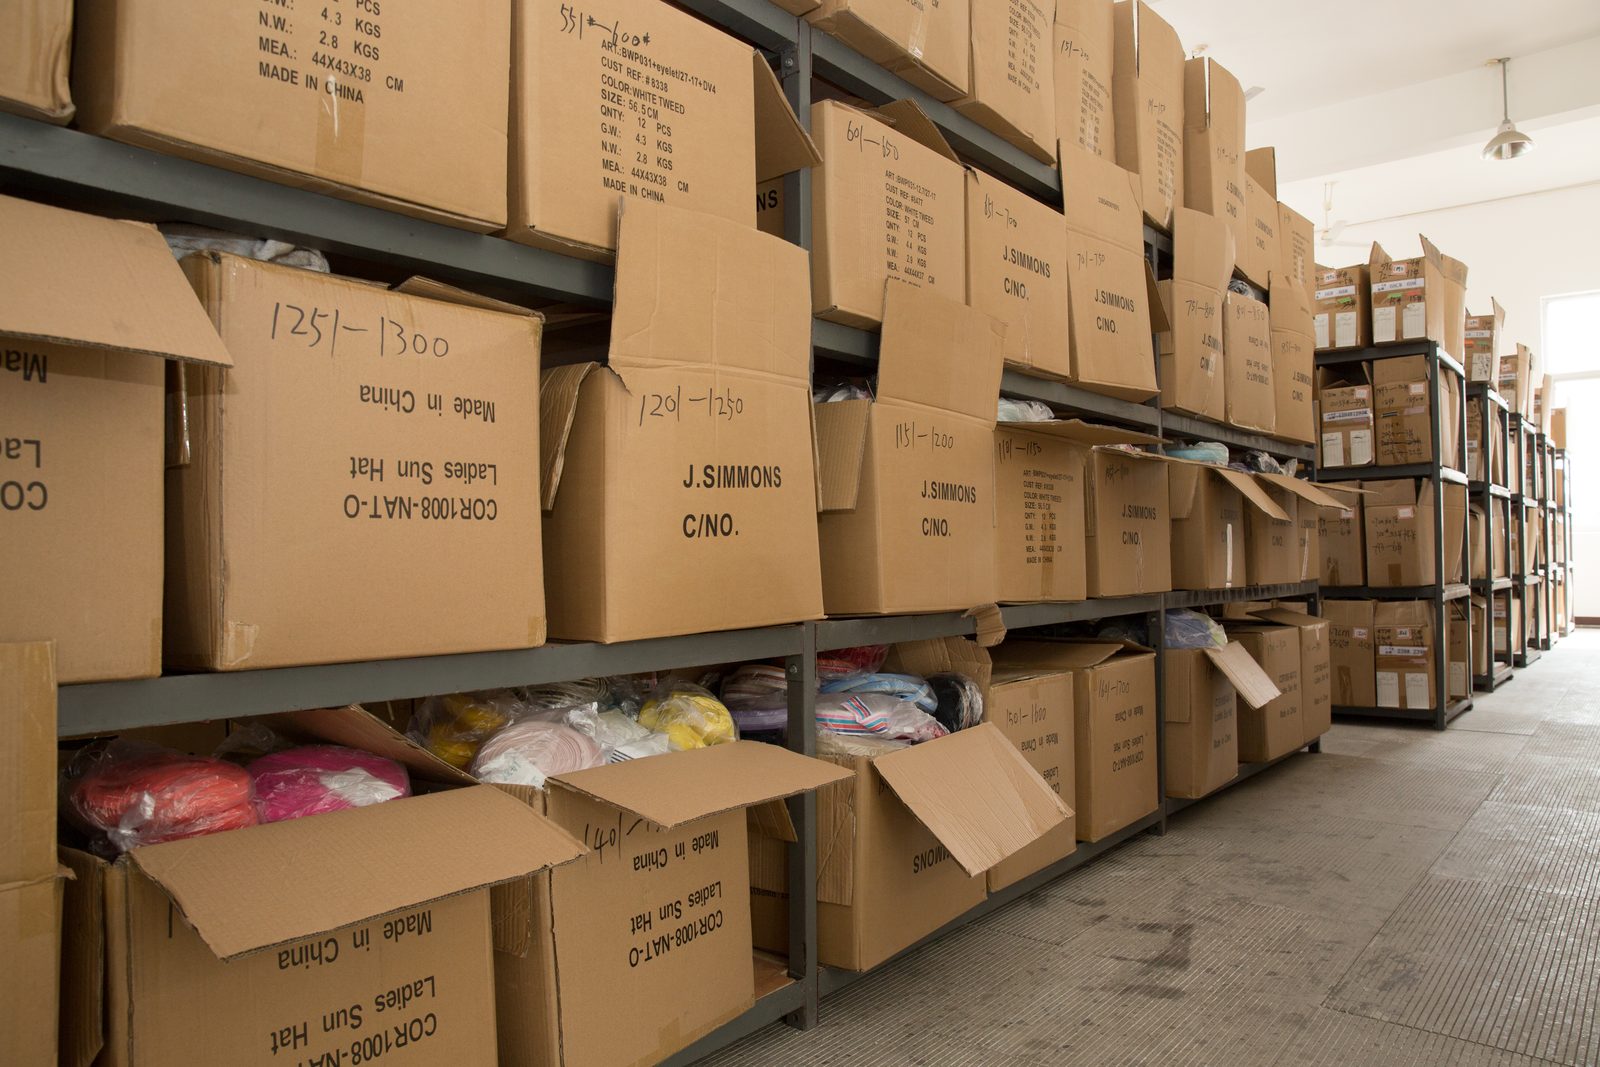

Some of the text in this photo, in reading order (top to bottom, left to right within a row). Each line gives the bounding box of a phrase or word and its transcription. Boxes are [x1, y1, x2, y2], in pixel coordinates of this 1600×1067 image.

[259, 11, 380, 61] N.W.: 2.8 KGS
[321, 7, 381, 39] 4.3 KGS
[259, 36, 404, 92] MEA.: 44X43X38 CM
[601, 56, 623, 74] CUST
[626, 66, 645, 83] REF:
[259, 62, 364, 104] MADE IN CHINA
[601, 88, 626, 107] SIZE:
[600, 105, 672, 137] QNTY: 12 PCS
[659, 96, 685, 115] TWEED
[600, 122, 673, 154] G.W.: 4.3 KGS
[601, 140, 673, 171] N.W.: 2.8 KGS
[602, 158, 689, 193] MEA.: 44X43X38 CM
[603, 177, 665, 203] MADE IN CHINA
[917, 231, 926, 242] PCS
[917, 244, 926, 255] KGS
[917, 257, 926, 267] KGS
[1002, 245, 1051, 279] J.SIMMONS
[1094, 288, 1135, 313] J.SIMMONS
[271, 302, 450, 359] 1251-1300
[359, 384, 496, 424] Made in China
[639, 385, 744, 427] 1201-1250
[349, 456, 498, 486] Ladies Sun Hat
[682, 464, 782, 488] J.SIMMONS
[921, 479, 976, 504] J.SIMMONS
[343, 494, 498, 521] COR1008-NAT-O
[1121, 503, 1157, 521] J.SIMMONS
[682, 512, 739, 538] C/NO.
[921, 517, 952, 537] C/NO.
[632, 829, 719, 873] Made in China
[629, 880, 723, 936] Ladies Sun Hat
[277, 909, 433, 970] Made in China
[628, 909, 724, 968] COR1008-NAT-O
[269, 974, 436, 1057] Ladies Sun Hat
